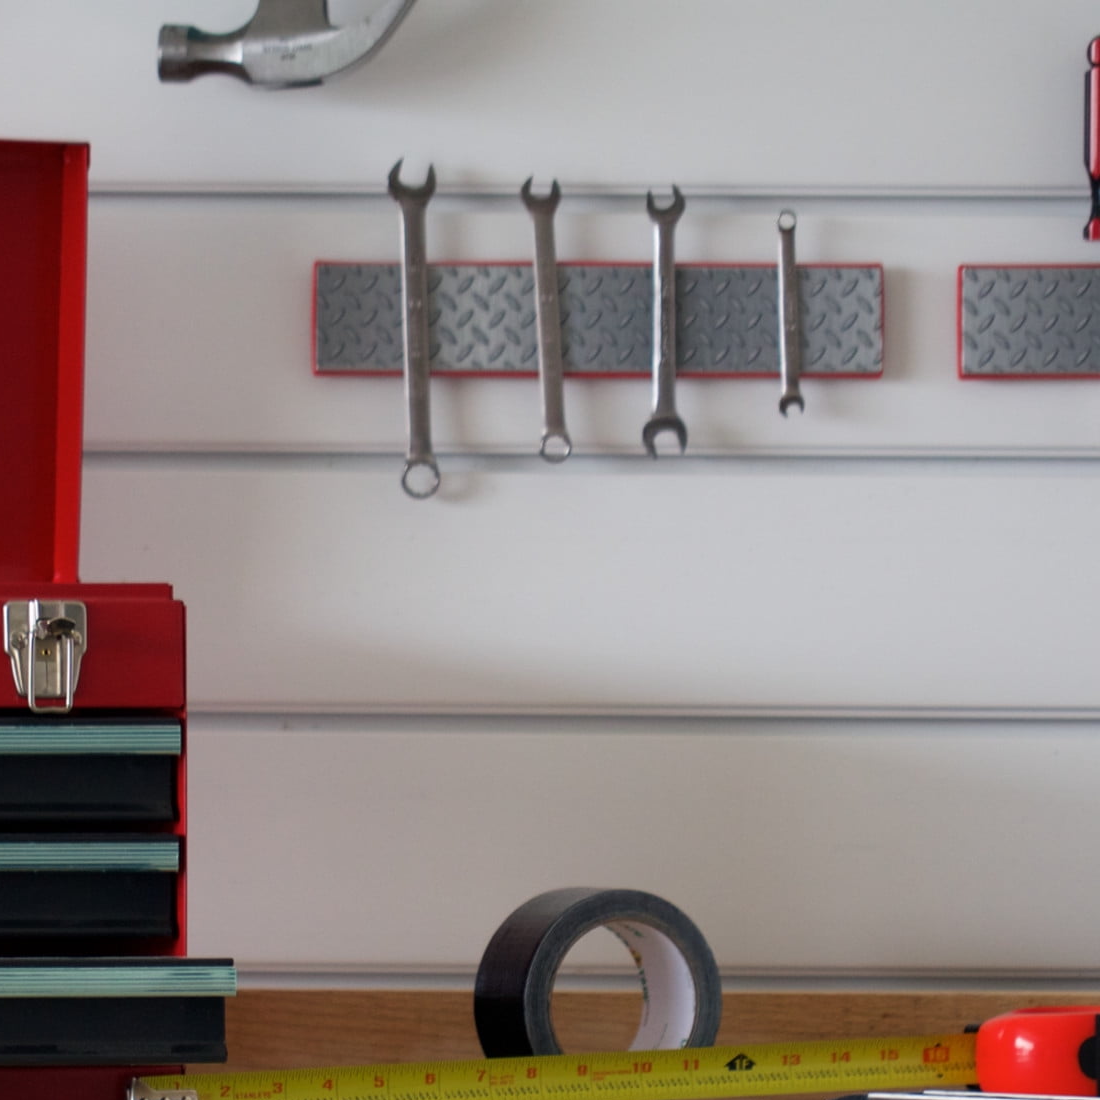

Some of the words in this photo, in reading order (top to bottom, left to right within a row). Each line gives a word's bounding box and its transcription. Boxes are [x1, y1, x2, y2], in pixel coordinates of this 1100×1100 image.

[219, 1085, 232, 1098] 2
[272, 1082, 284, 1095] 3
[321, 1079, 334, 1091] 4
[373, 1075, 386, 1088] 5
[424, 1073, 436, 1085] 6
[476, 1069, 487, 1082] 7
[526, 1067, 538, 1079] 8
[577, 1064, 588, 1077] 9
[632, 1062, 653, 1074] 10
[682, 1058, 701, 1071] 11
[780, 1053, 802, 1066] 13
[830, 1051, 852, 1064] 14
[878, 1048, 899, 1061] 15
